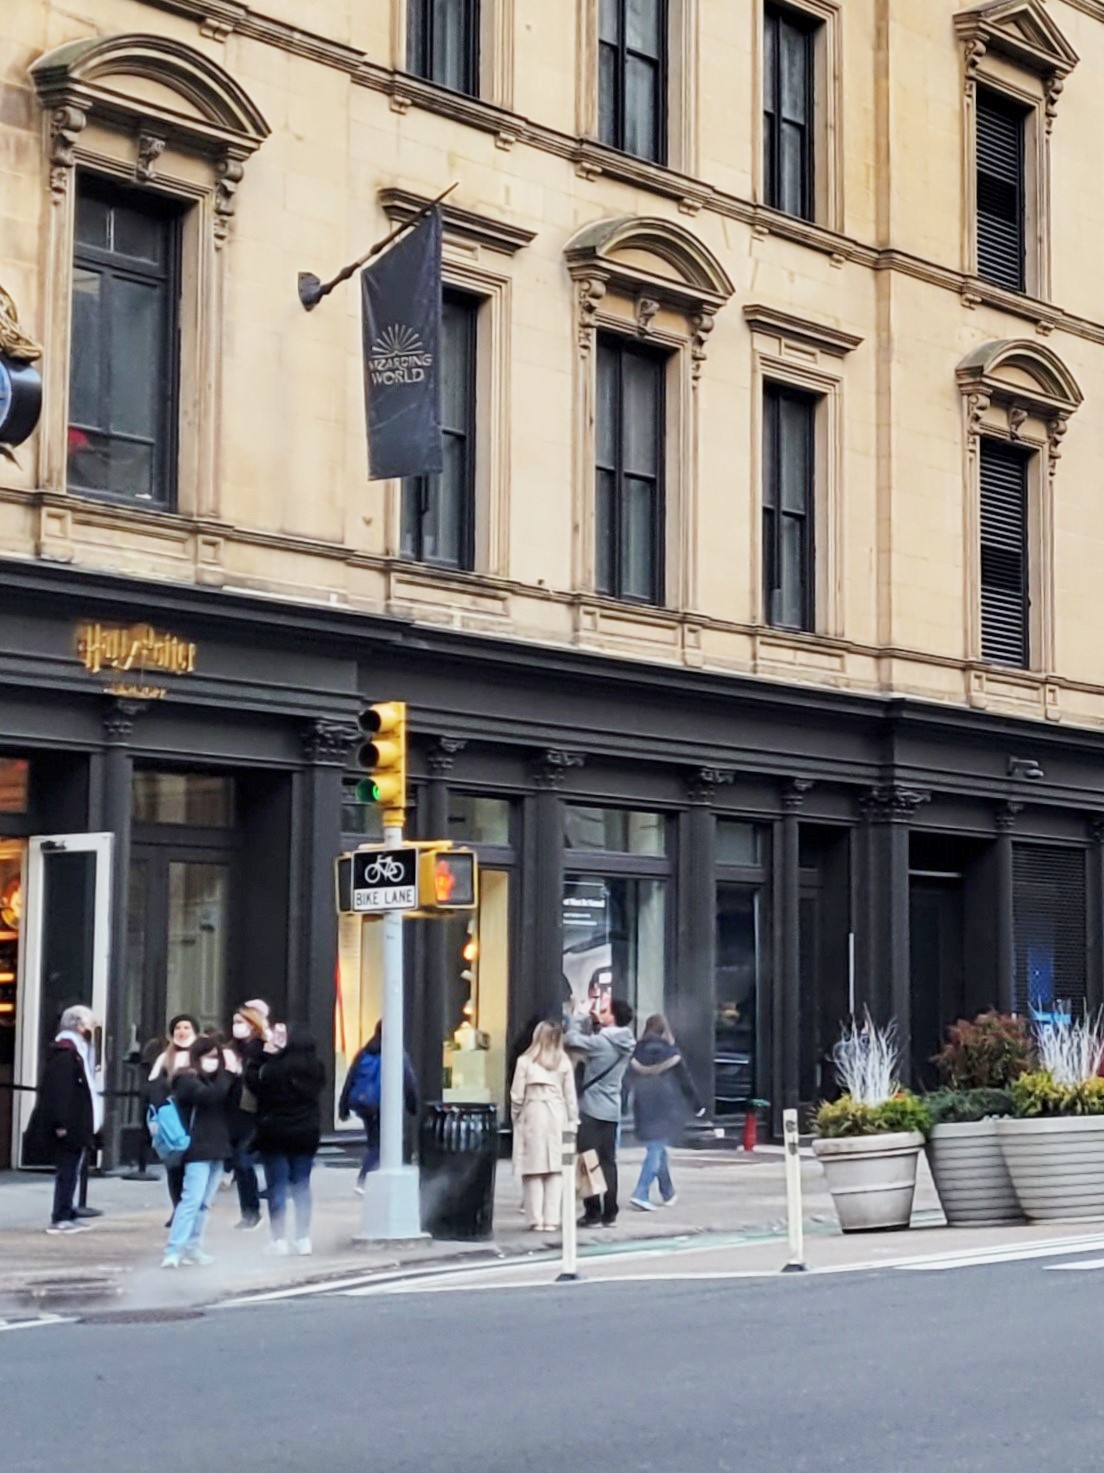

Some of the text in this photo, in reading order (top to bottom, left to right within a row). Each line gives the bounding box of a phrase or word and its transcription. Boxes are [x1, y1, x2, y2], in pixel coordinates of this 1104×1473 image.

[371, 368, 425, 386] WORLD
[78, 623, 197, 675] Harry Potter
[356, 889, 413, 907] BIKE LANE
